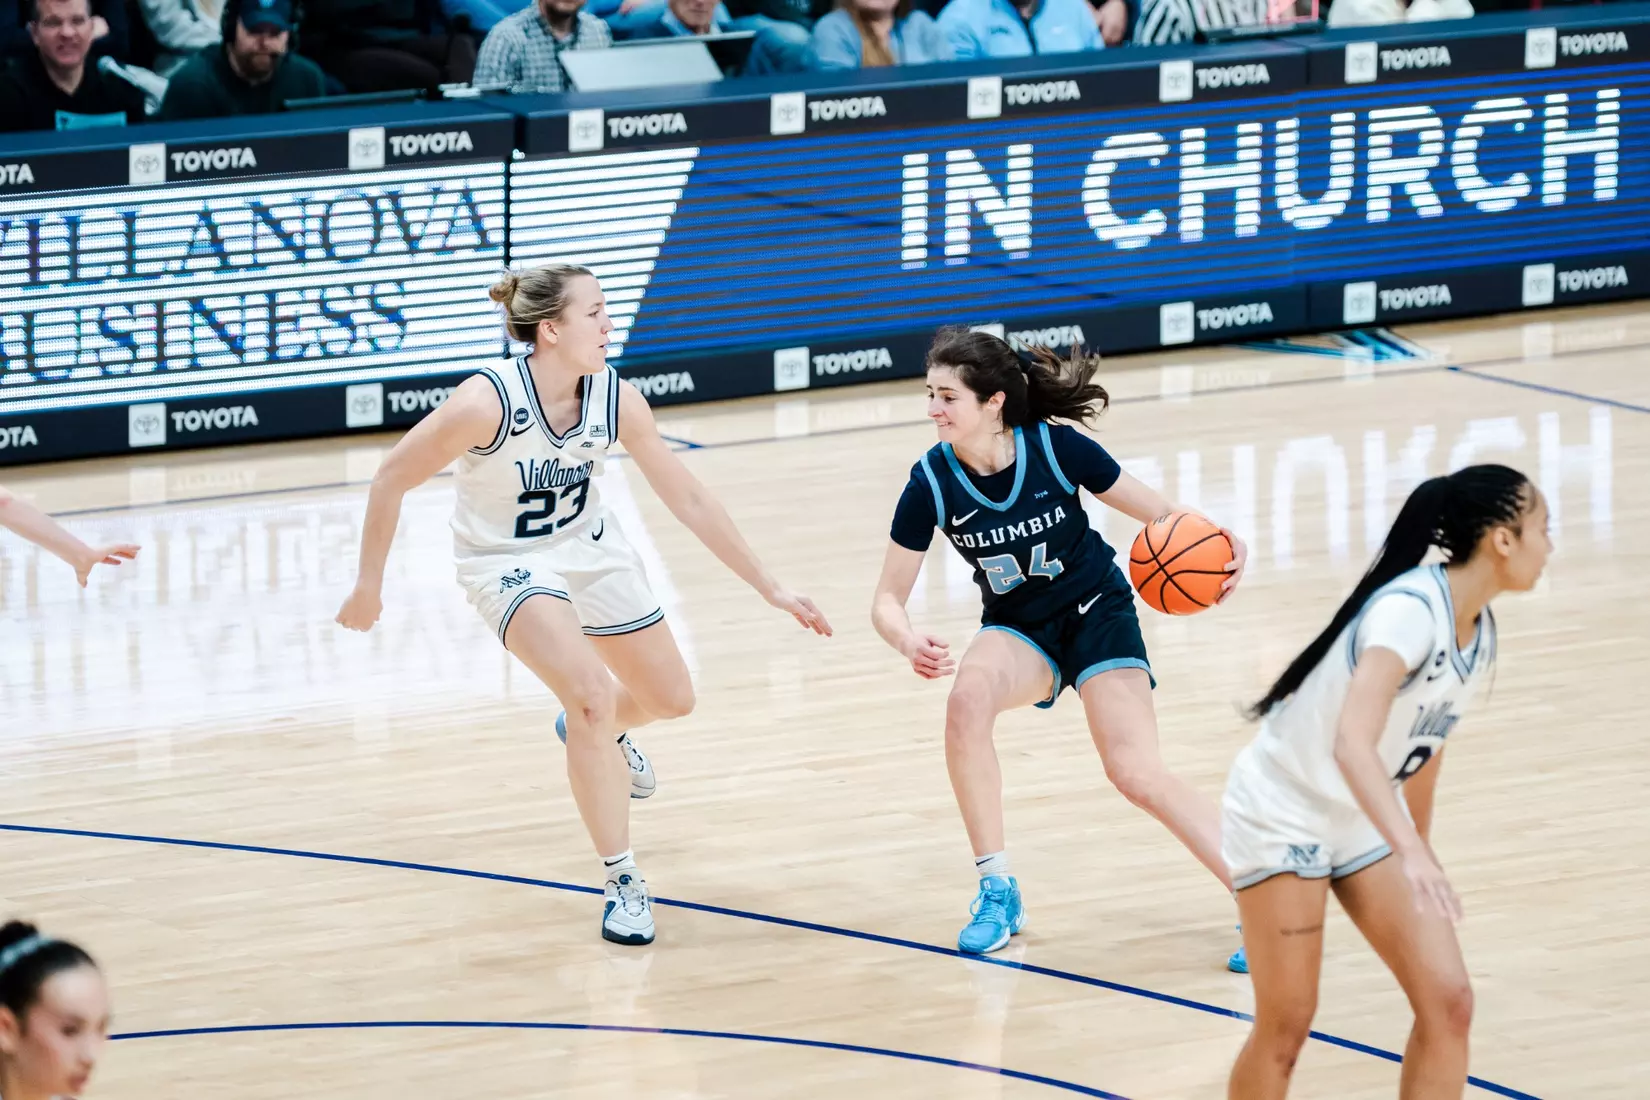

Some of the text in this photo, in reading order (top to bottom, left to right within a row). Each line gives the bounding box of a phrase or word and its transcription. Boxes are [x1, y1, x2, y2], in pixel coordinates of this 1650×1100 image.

[1560, 32, 1628, 55] TOYOTA
[1381, 46, 1451, 70] TOYOTA
[1196, 63, 1270, 88] TOYOTA
[1004, 80, 1081, 105] TOYOTA
[808, 96, 887, 121] TOYOTA
[607, 112, 687, 138] TOYOTA
[389, 130, 473, 156] TOYOTA
[170, 147, 257, 172] TOYOTA
[901, 88, 1621, 269] IN CHURCH
[1559, 265, 1628, 291] TOYOTA
[1379, 284, 1452, 310] TOYOTA
[1198, 302, 1274, 330] TOYOTA
[0, 282, 404, 380] USINESS
[1006, 324, 1086, 352] TOYOTA
[812, 347, 893, 376] TOYOTA
[387, 387, 457, 413] TOYO
[171, 405, 259, 432] TOYOTA
[514, 477, 590, 538] 23
[951, 505, 1067, 549] COLUMBIA
[976, 541, 1065, 595] 24
